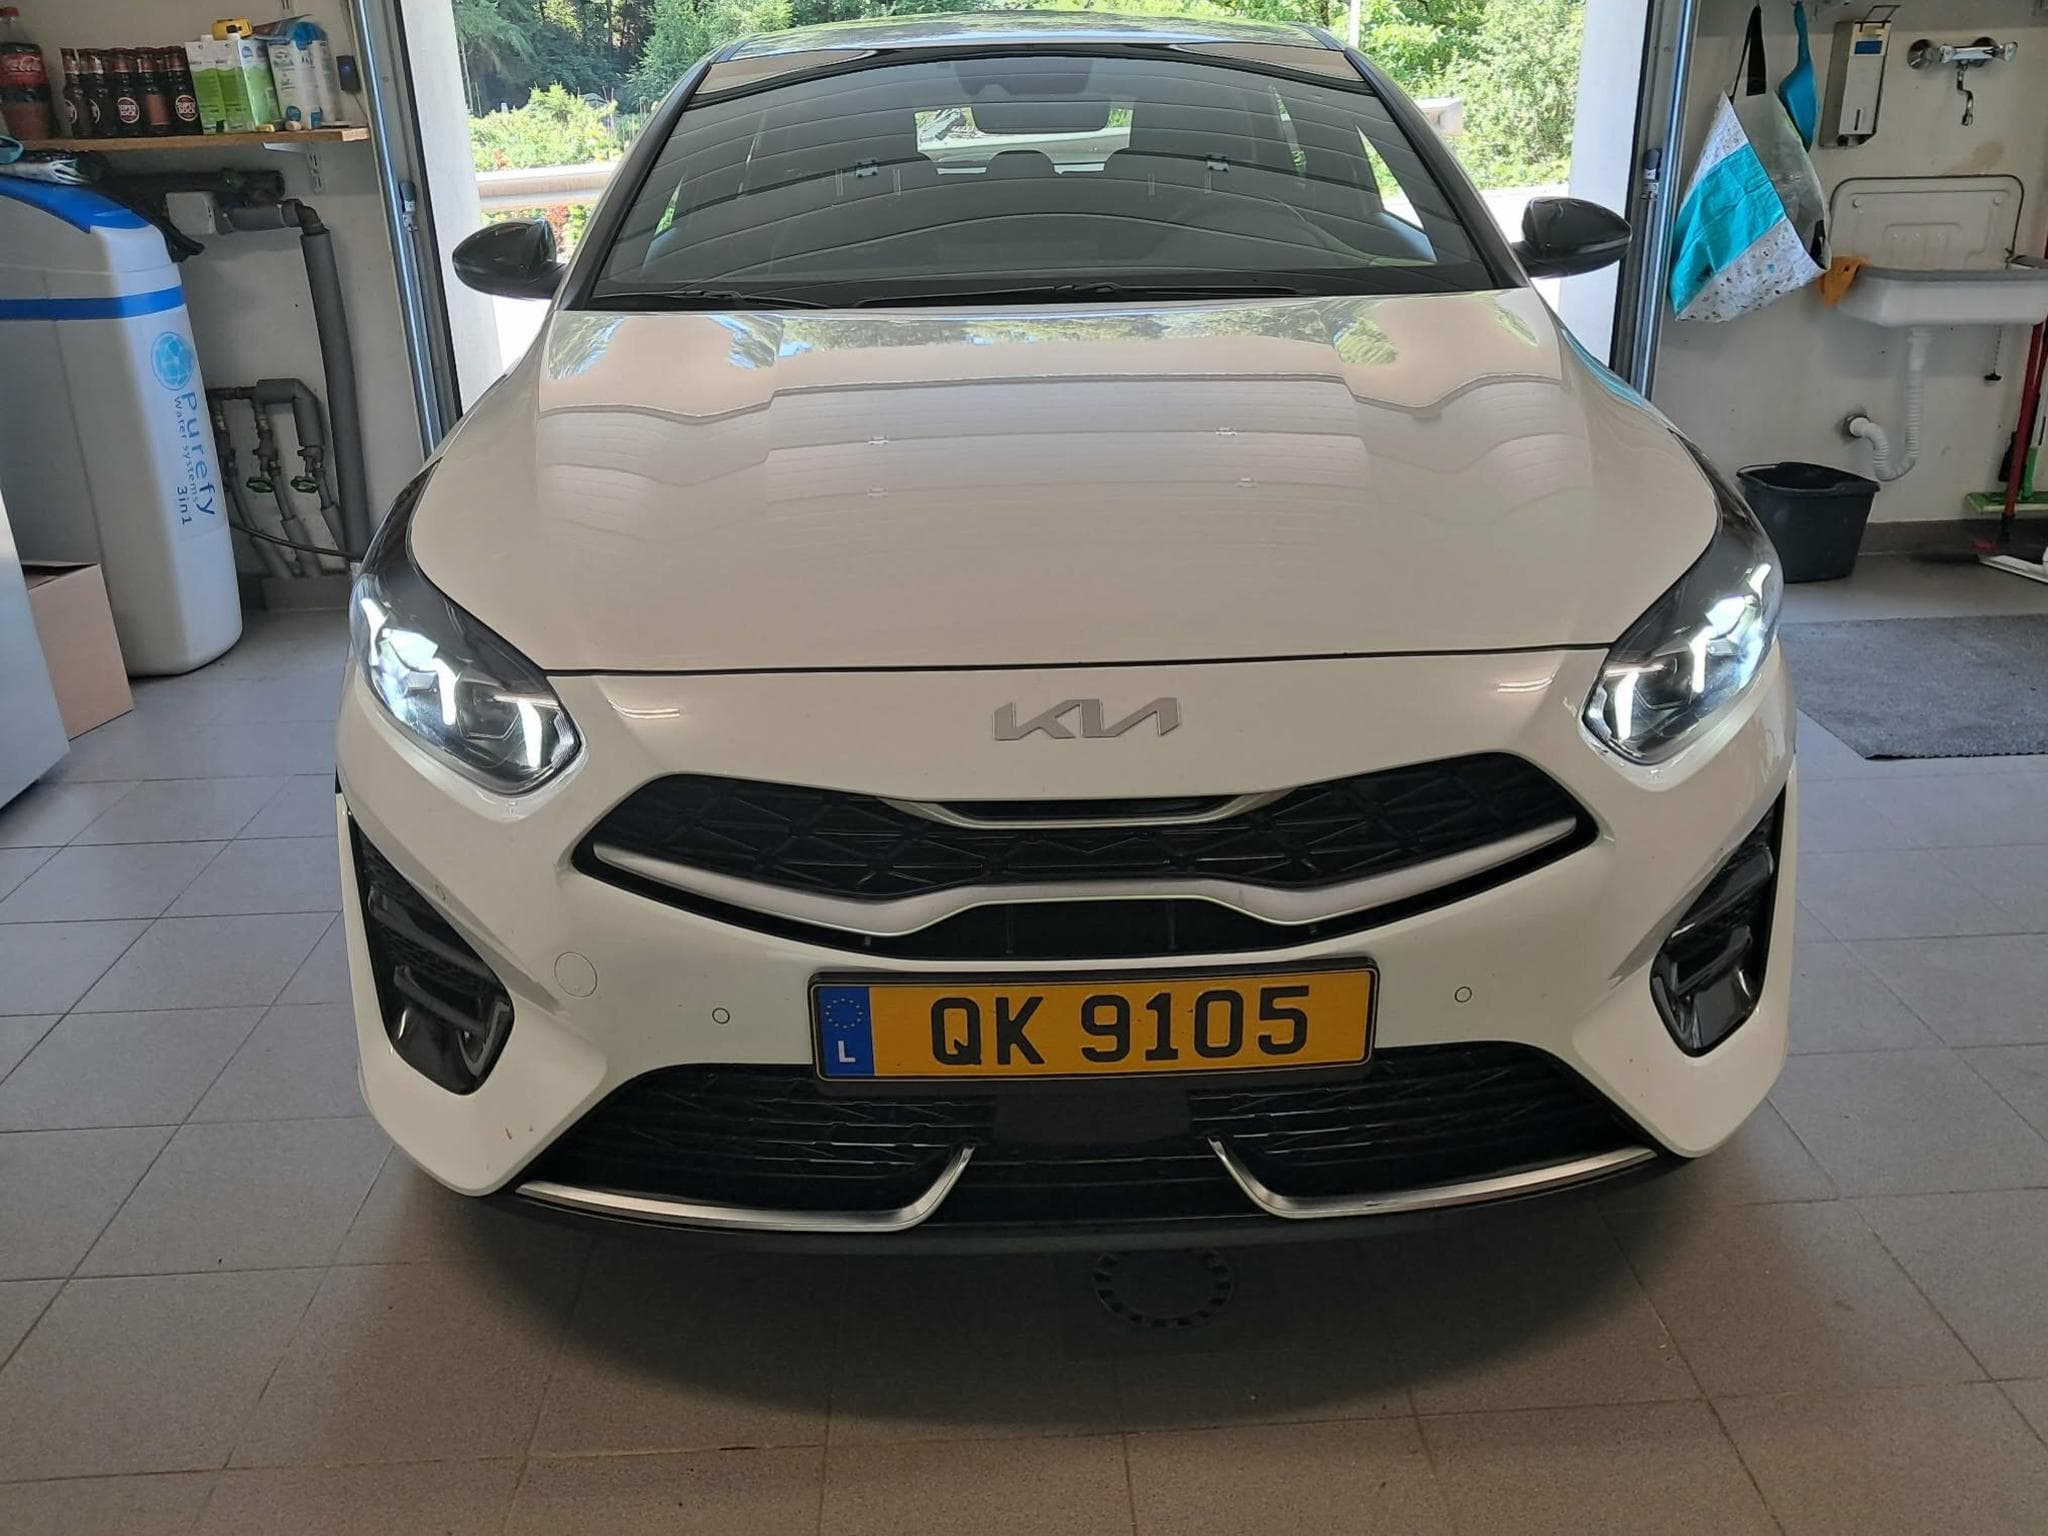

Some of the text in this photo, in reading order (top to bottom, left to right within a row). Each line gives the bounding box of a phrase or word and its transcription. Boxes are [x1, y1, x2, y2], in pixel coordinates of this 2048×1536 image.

[174, 396, 188, 439] Water
[182, 392, 215, 515] Purefy
[992, 697, 1181, 741] KIA
[930, 986, 1310, 1066] QK 9105
[837, 1039, 856, 1064] L
